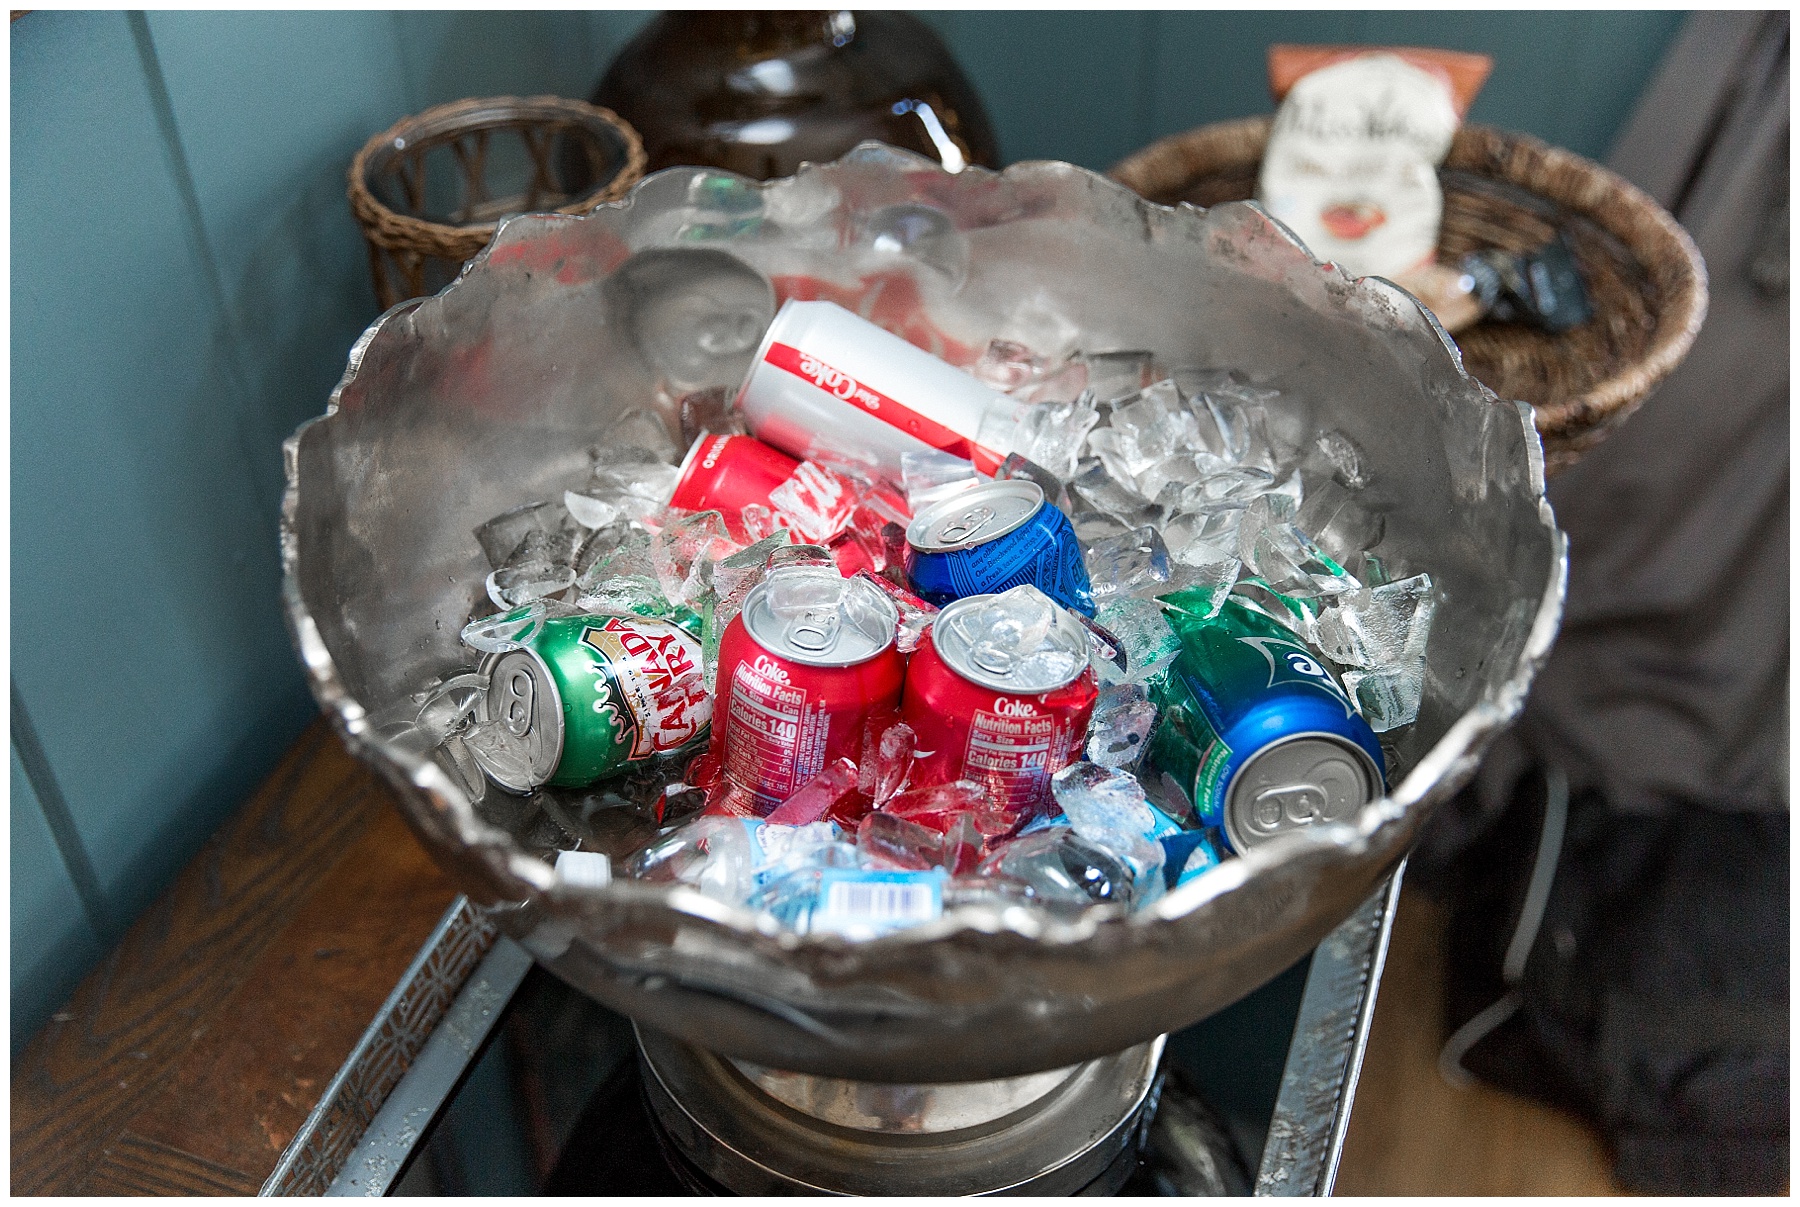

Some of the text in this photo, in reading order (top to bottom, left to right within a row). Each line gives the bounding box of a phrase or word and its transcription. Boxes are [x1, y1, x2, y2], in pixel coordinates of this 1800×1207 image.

[975, 564, 988, 578] Our
[604, 618, 697, 751] CANADA
[736, 664, 802, 705] Nutrition Facts
[734, 679, 748, 697] Serv.
[749, 689, 764, 704] Size
[782, 705, 799, 716] Can
[729, 720, 740, 733] Total
[741, 730, 752, 740] Fat
[731, 699, 797, 739] Calories 140
[974, 713, 1051, 735] Nutrition Facts
[972, 729, 993, 743] Serv.
[996, 734, 1015, 745] Size
[1035, 735, 1051, 744] Can
[739, 747, 753, 761] Carb.
[968, 750, 1017, 769] Calories
[1020, 751, 1047, 768] 140
[1206, 747, 1229, 787] Nutrition
[1203, 787, 1212, 812] Facts
